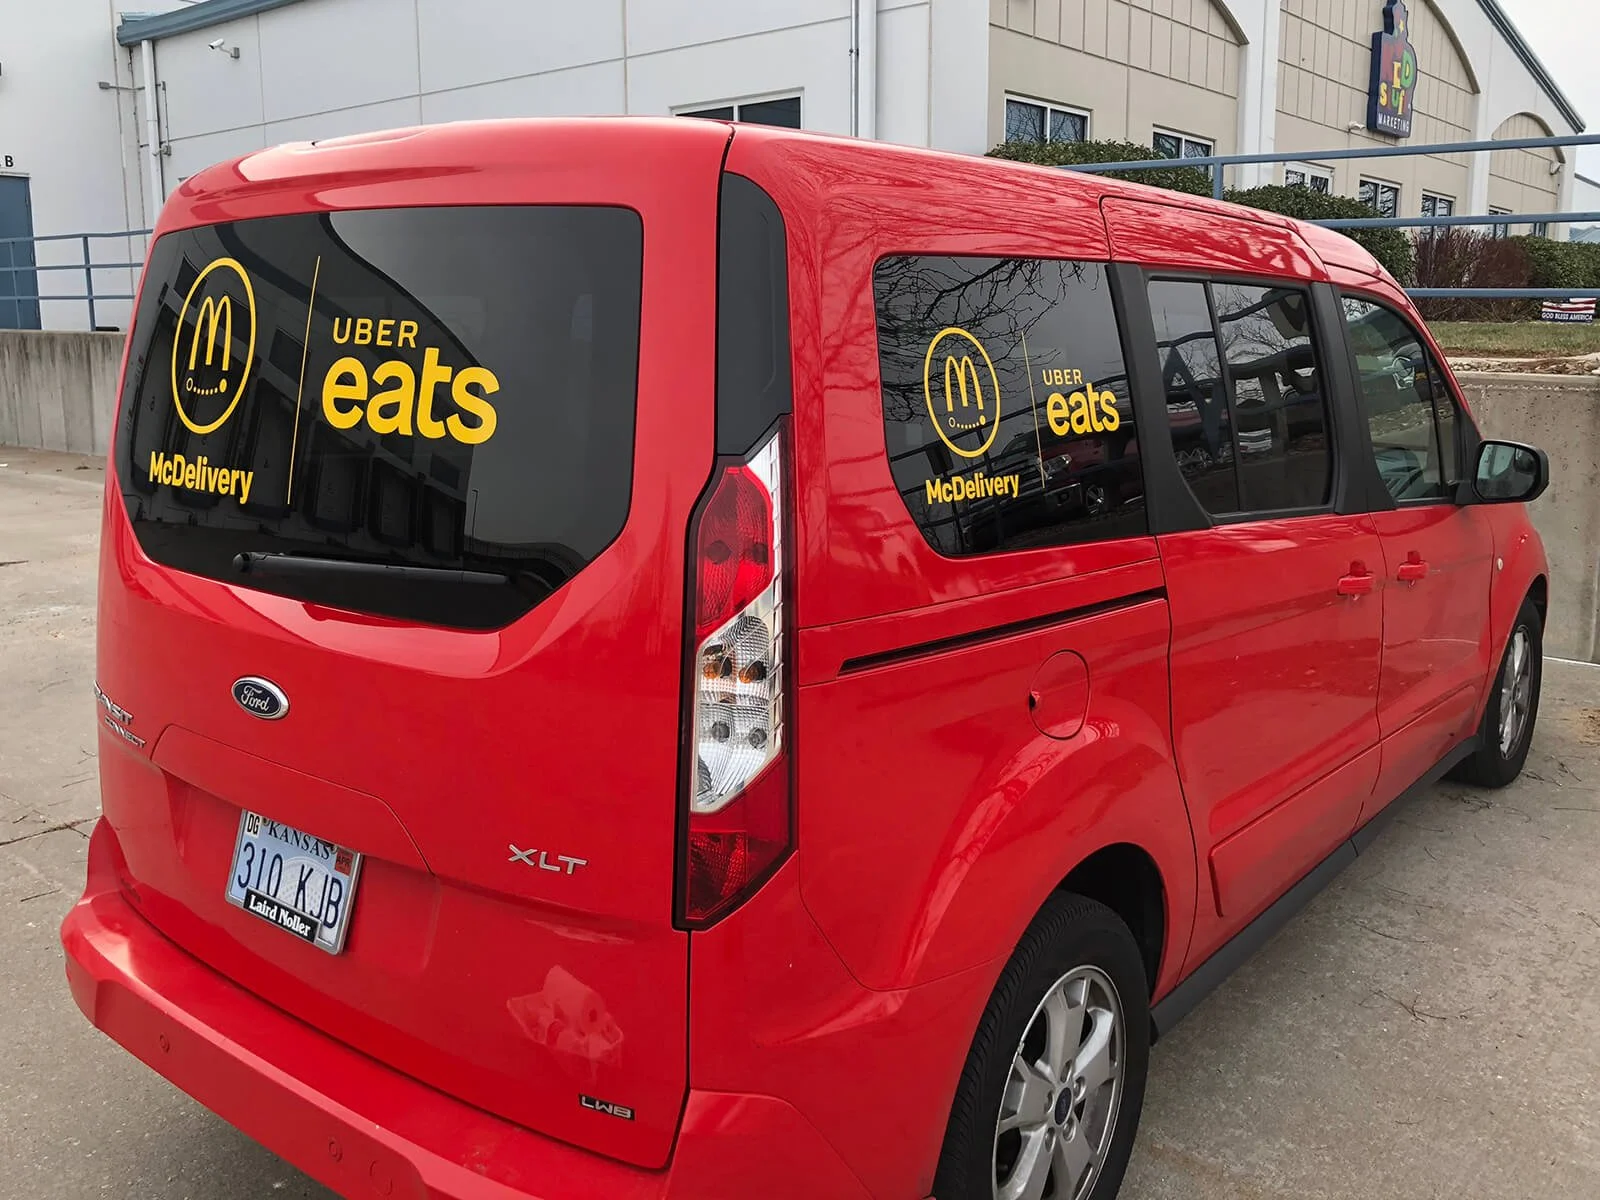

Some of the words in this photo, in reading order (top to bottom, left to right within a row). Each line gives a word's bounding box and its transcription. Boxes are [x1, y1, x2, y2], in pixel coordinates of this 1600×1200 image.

[1378, 112, 1410, 133] MARKETING
[4, 154, 15, 168] B
[332, 316, 419, 349] UBER
[1554, 312, 1569, 320] BLESS
[1569, 313, 1593, 321] AMERICA
[1042, 368, 1083, 386] UBER
[321, 346, 501, 445] eats
[1046, 382, 1121, 437] eats
[148, 450, 254, 505] McDelivery
[925, 471, 1020, 505] McDelivery
[240, 685, 270, 712] Ford
[247, 813, 261, 836] DG
[268, 820, 331, 861] KANSAS
[507, 843, 589, 875] XLT
[237, 841, 284, 900] 310
[294, 863, 343, 929] KJB
[249, 893, 279, 922] Laird
[278, 908, 312, 937] Noller
[580, 1095, 633, 1120] LWB
